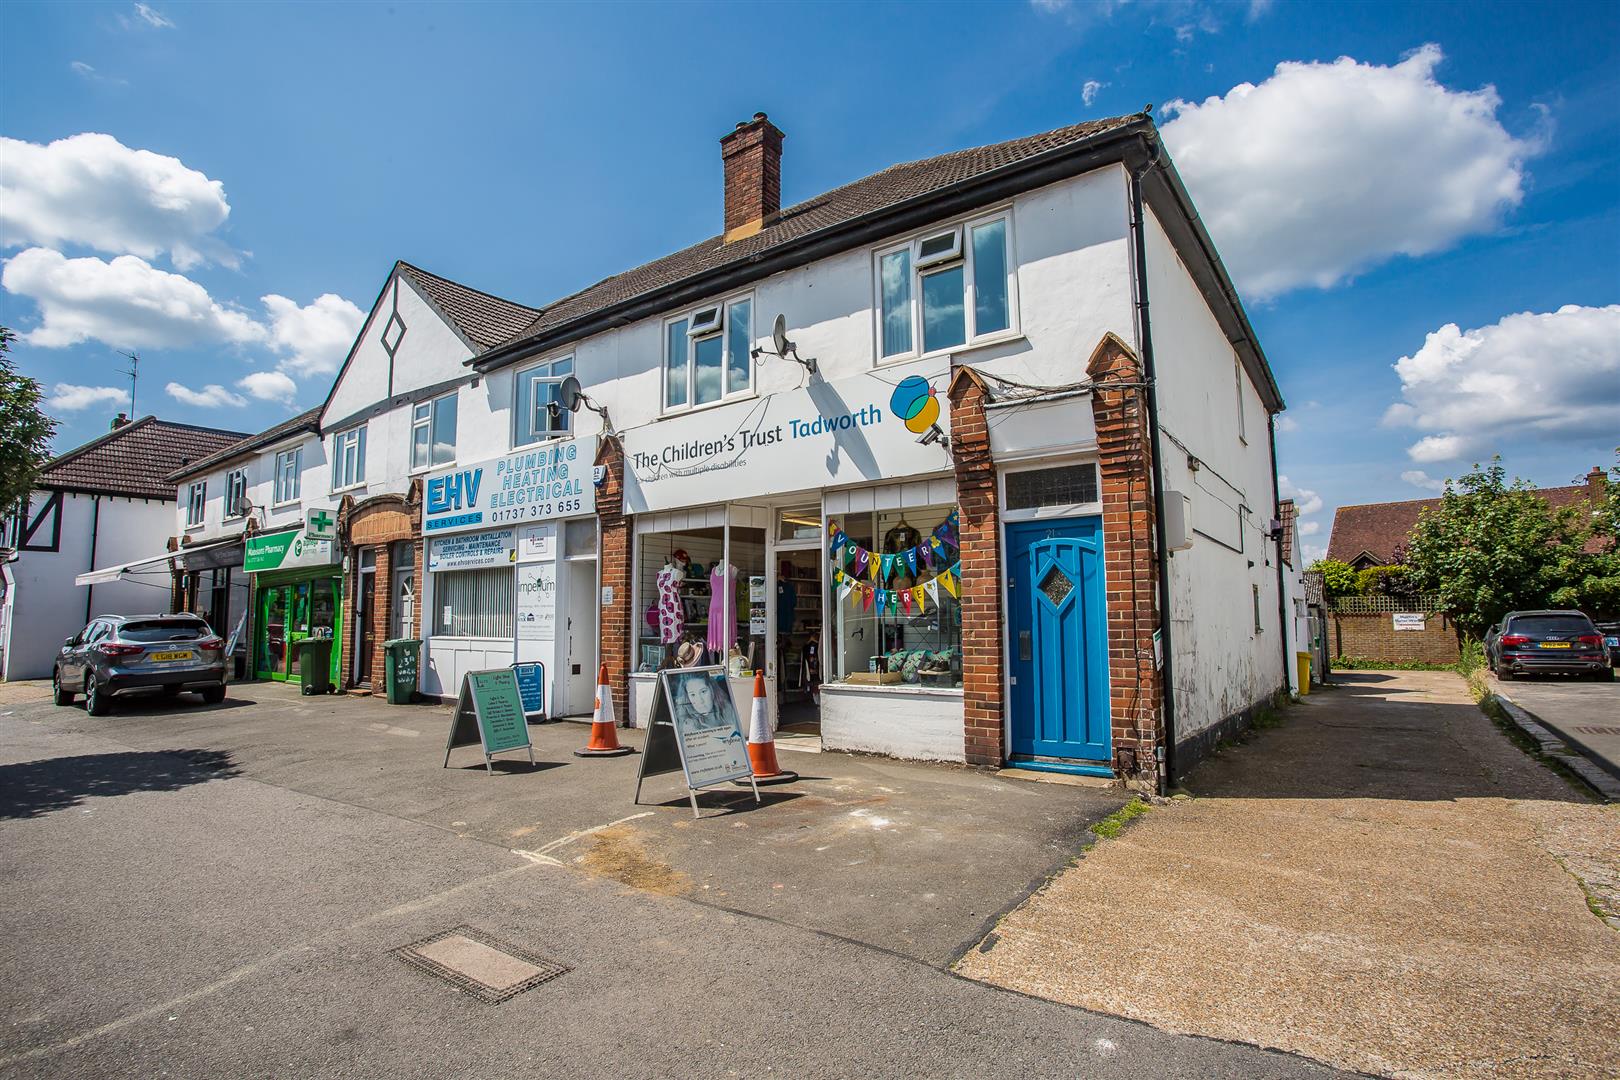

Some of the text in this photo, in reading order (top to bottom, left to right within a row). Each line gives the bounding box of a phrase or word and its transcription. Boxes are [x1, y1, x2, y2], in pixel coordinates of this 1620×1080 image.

[633, 404, 881, 470] The Children's Trust Tadworth
[497, 444, 577, 476] PLUMBING
[502, 463, 569, 491] HEATING
[427, 467, 483, 515] EHV
[490, 478, 583, 509] ELECTRICAL
[492, 498, 581, 522] 01737 373 655
[427, 513, 481, 529] SERVICES
[309, 532, 334, 540] Pharmacy
[434, 538, 451, 547] KITCHEN
[455, 535, 479, 545] BATHROOM
[480, 530, 512, 541] INSTALLATION
[265, 545, 285, 554] Pharmacy
[442, 544, 465, 553] SERVICING
[468, 540, 501, 550] MAINTENANCE
[455, 549, 479, 558] CONTROLS
[484, 547, 504, 555] REPAIRS
[878, 589, 922, 604] HERE
